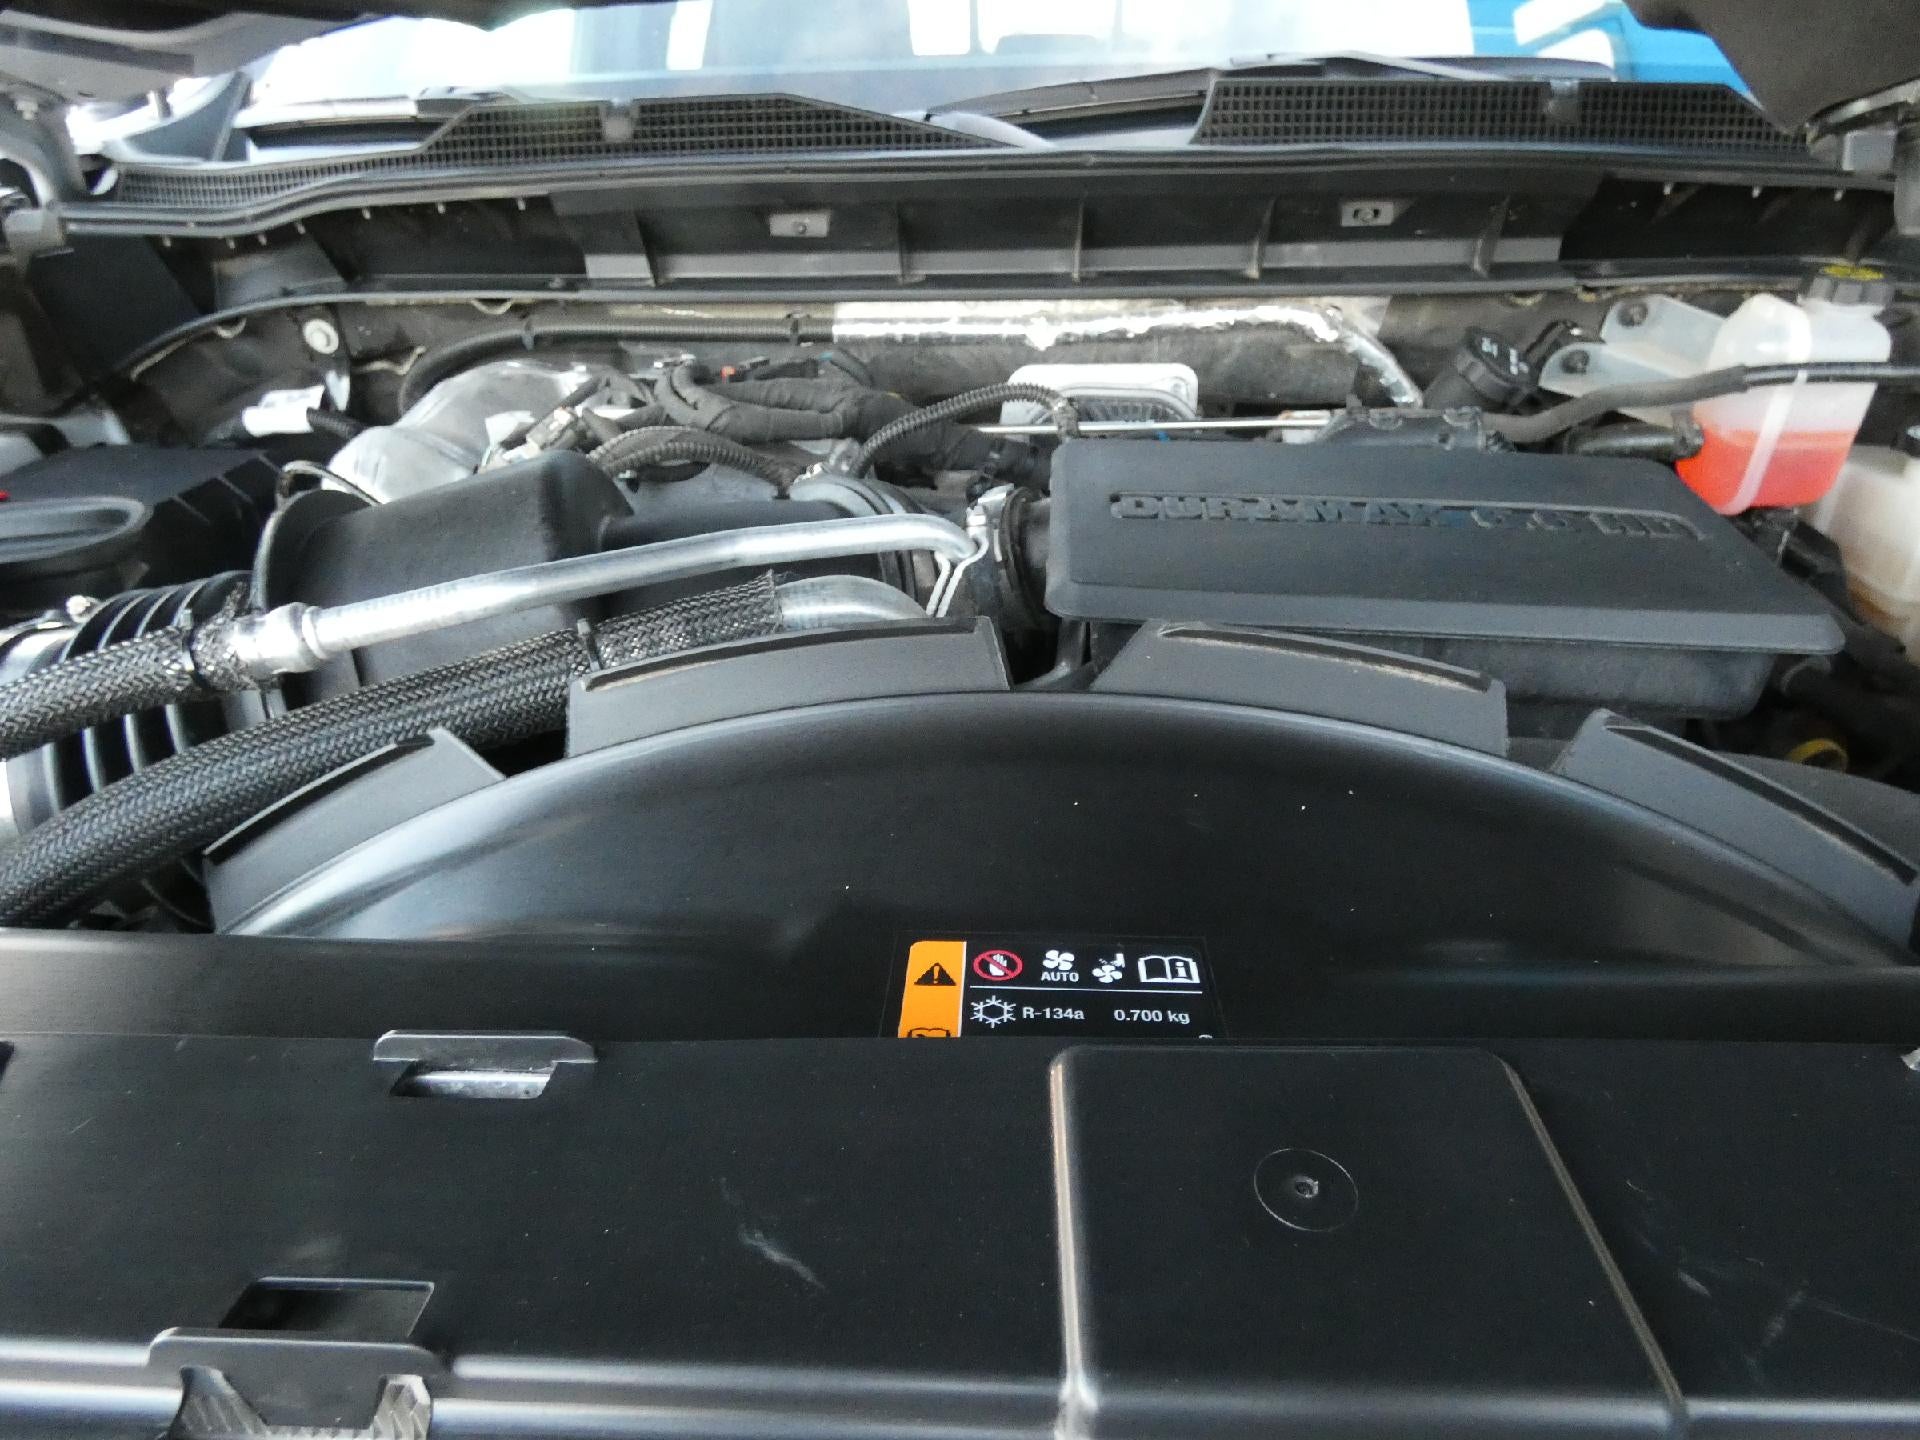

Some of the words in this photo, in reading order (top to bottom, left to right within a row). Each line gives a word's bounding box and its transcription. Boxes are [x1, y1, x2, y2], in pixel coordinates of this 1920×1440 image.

[1112, 493, 1440, 526] DURAMAX
[1040, 971, 1079, 982] AUTO
[1022, 1006, 1085, 1020] R-134a
[1113, 1009, 1163, 1022] 0.700
[1167, 1009, 1191, 1025] kg
